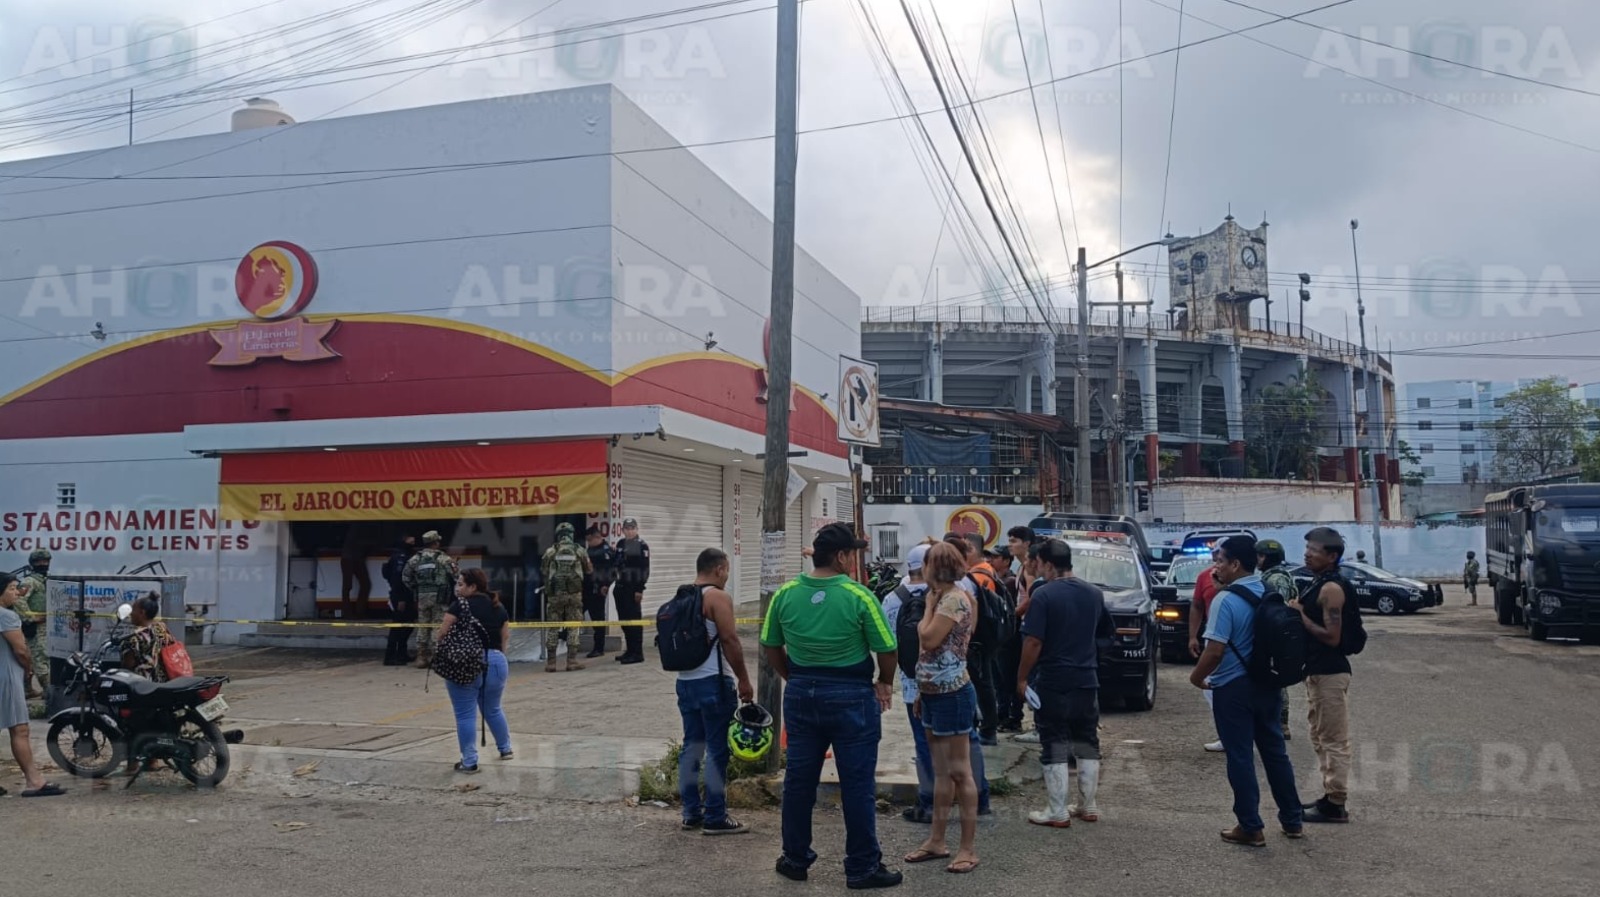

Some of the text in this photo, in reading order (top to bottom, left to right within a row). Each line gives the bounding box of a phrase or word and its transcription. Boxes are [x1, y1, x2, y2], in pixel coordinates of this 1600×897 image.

[260, 493, 286, 511] EL
[293, 490, 395, 511] JAROCHO
[1055, 522, 1112, 532] TABASCO
[131, 534, 250, 551] CLIENTES
